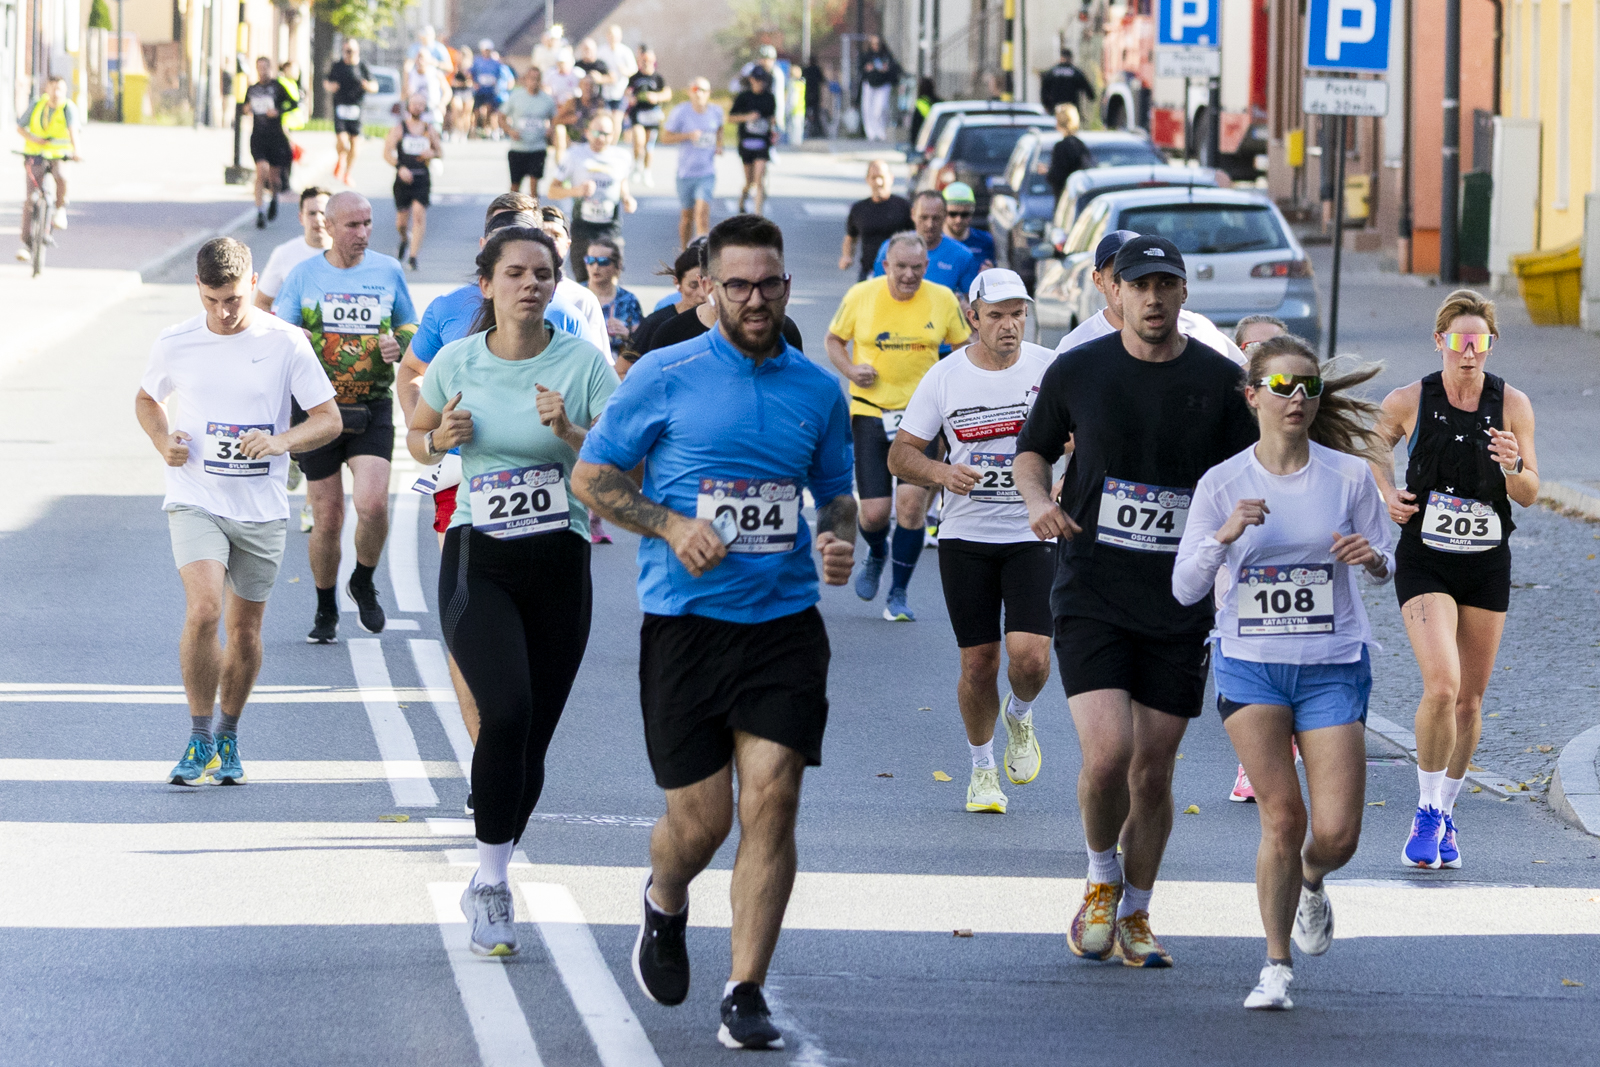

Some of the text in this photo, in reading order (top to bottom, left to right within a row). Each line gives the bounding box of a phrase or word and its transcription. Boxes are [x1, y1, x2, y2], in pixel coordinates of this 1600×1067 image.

[1170, 0, 1210, 41] P
[1324, 0, 1377, 61] P
[333, 307, 372, 321] 040
[954, 414, 981, 424] EUROPEAN
[216, 441, 257, 460] 32
[983, 471, 1015, 488] 23
[488, 488, 552, 520] 220
[506, 517, 539, 529] KLAUDIA
[1117, 505, 1175, 533] 074
[1435, 514, 1489, 537] 203
[736, 534, 770, 544] ATEUSZ
[1131, 533, 1157, 543] OSKAR
[1254, 588, 1315, 614] 108
[1262, 617, 1309, 626] KATARZYNA
